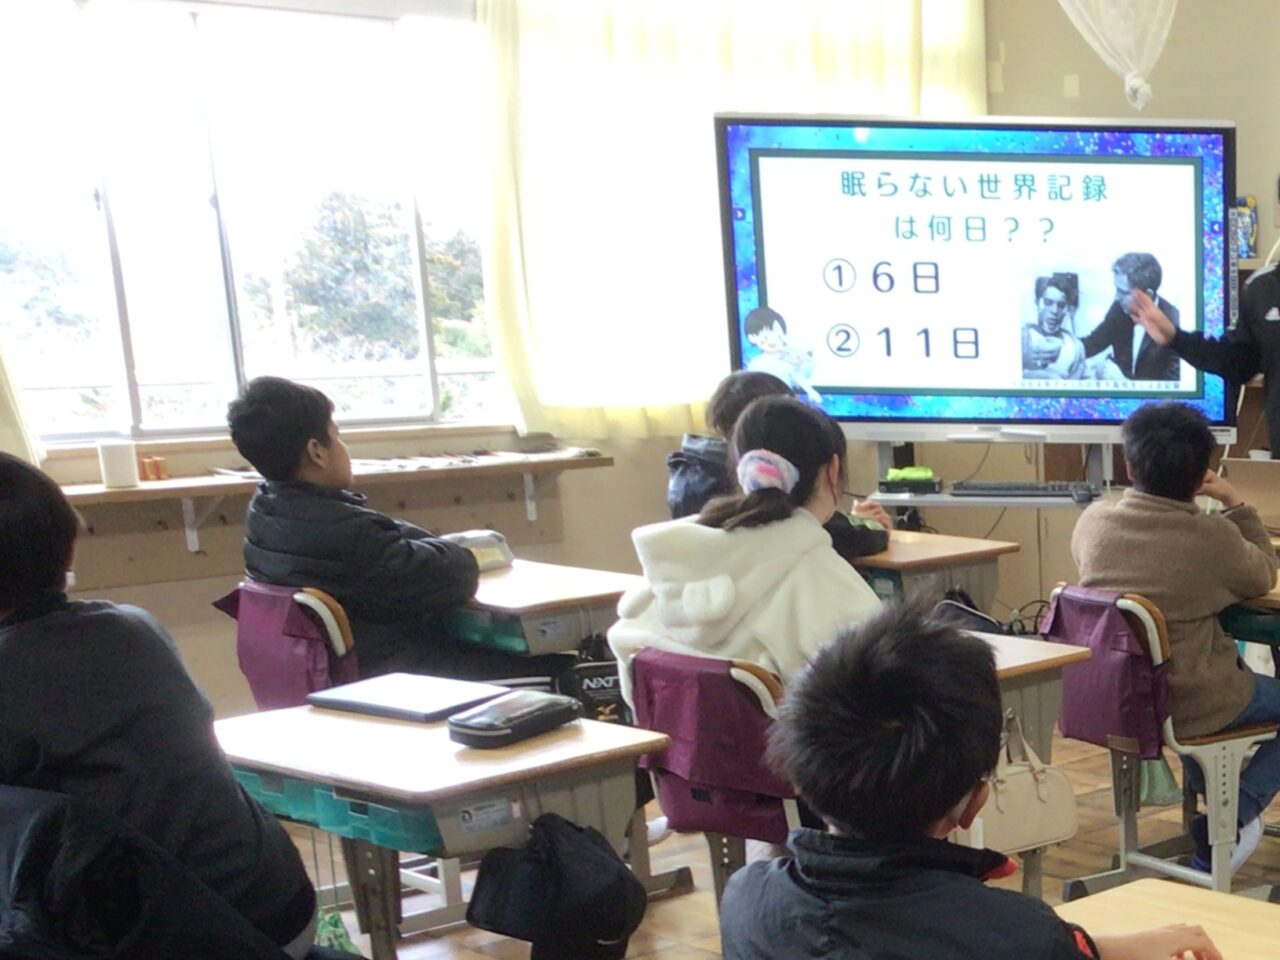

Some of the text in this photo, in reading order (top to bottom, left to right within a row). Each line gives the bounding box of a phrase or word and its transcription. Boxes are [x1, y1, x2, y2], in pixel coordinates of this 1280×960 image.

[840, 169, 1109, 203] 眠らない世界記録
[894, 214, 1056, 244] は何日？？
